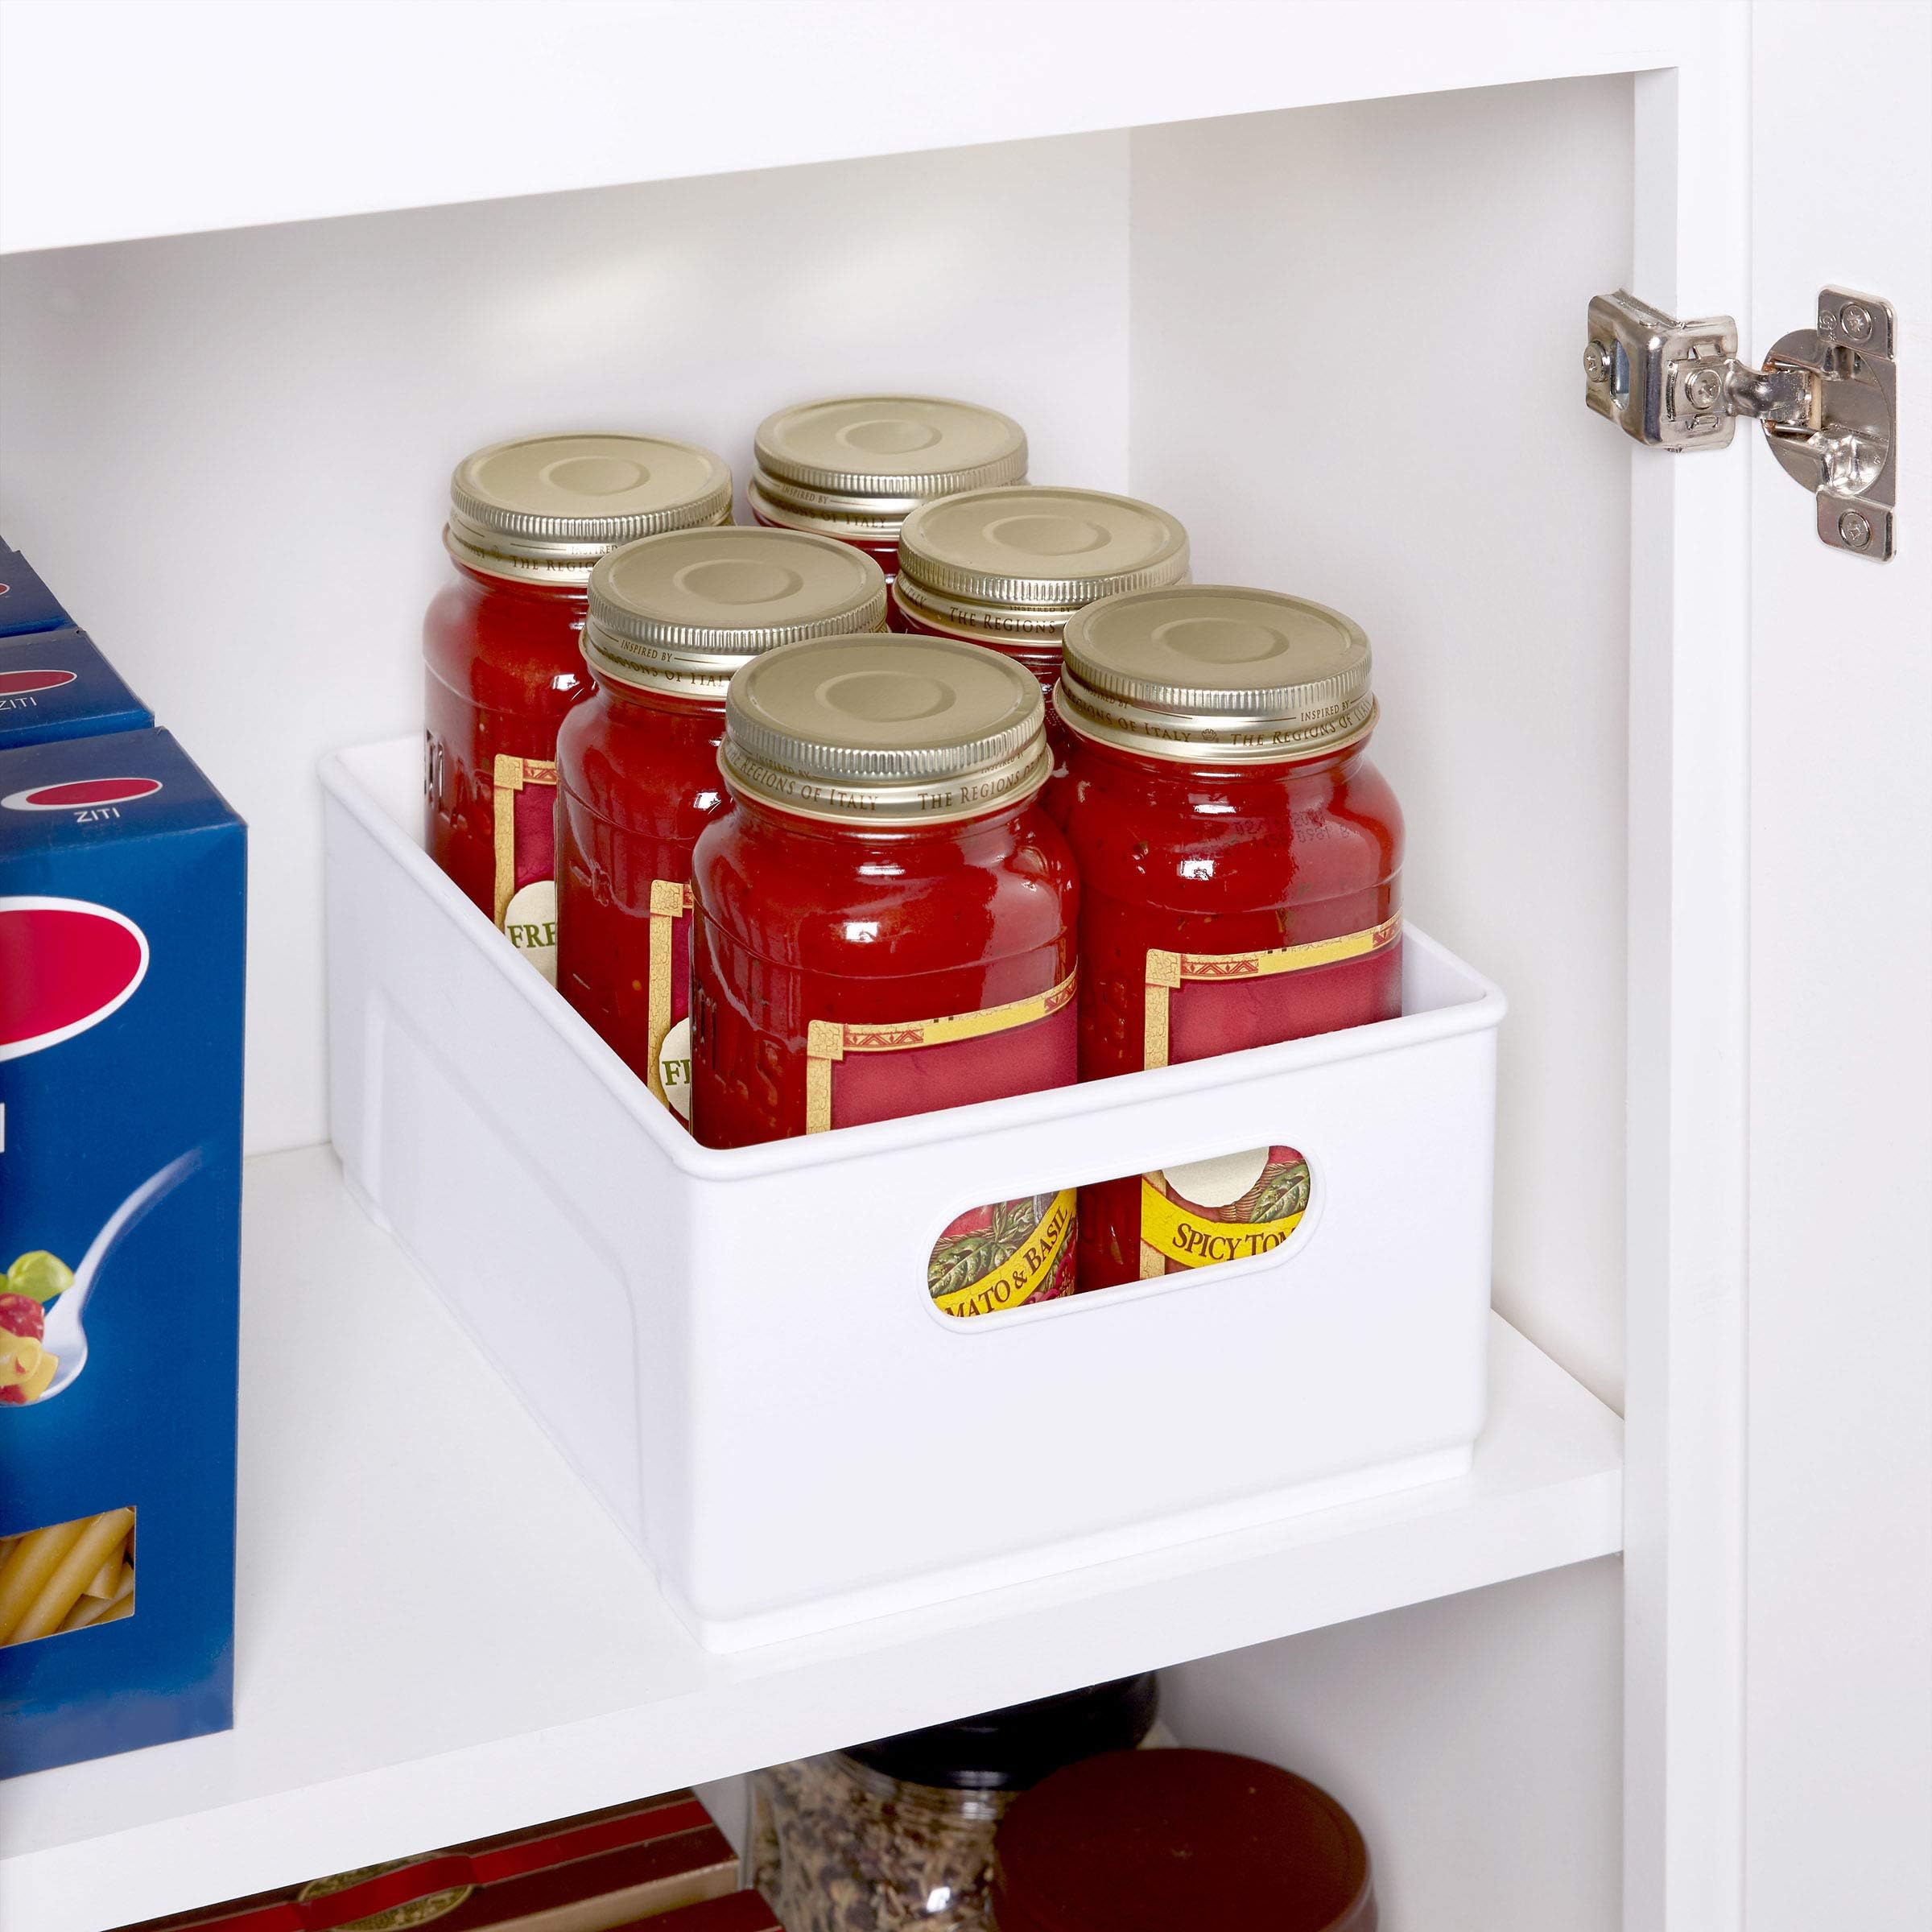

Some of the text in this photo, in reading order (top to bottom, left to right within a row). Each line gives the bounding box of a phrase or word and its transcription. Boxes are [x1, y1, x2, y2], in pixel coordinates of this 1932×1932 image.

[818, 495, 829, 505] BY
[846, 515, 886, 528] ITALY
[510, 555, 539, 571] THE
[950, 606, 1056, 634] THE REGIONS
[620, 639, 673, 663] INSPIRED BY
[0, 696, 38, 711] ZITI
[1300, 700, 1351, 722] INSPIRED BY
[1118, 717, 1137, 732] OF
[1144, 722, 1192, 743] ITALY
[1230, 733, 1265, 746] THE
[1272, 720, 1336, 745] REGIONS
[1339, 713, 1354, 729] OF
[740, 755, 796, 795] REGIONS
[800, 785, 822, 803] OF
[829, 788, 879, 811] ITALY
[917, 791, 953, 811] THE
[959, 770, 1021, 804] REGIONS
[73, 807, 121, 824] ZITI
[1012, 1270, 1028, 1290] &
[1022, 1207, 1069, 1276] BASIL
[1172, 1222, 1242, 1261] SPICY
